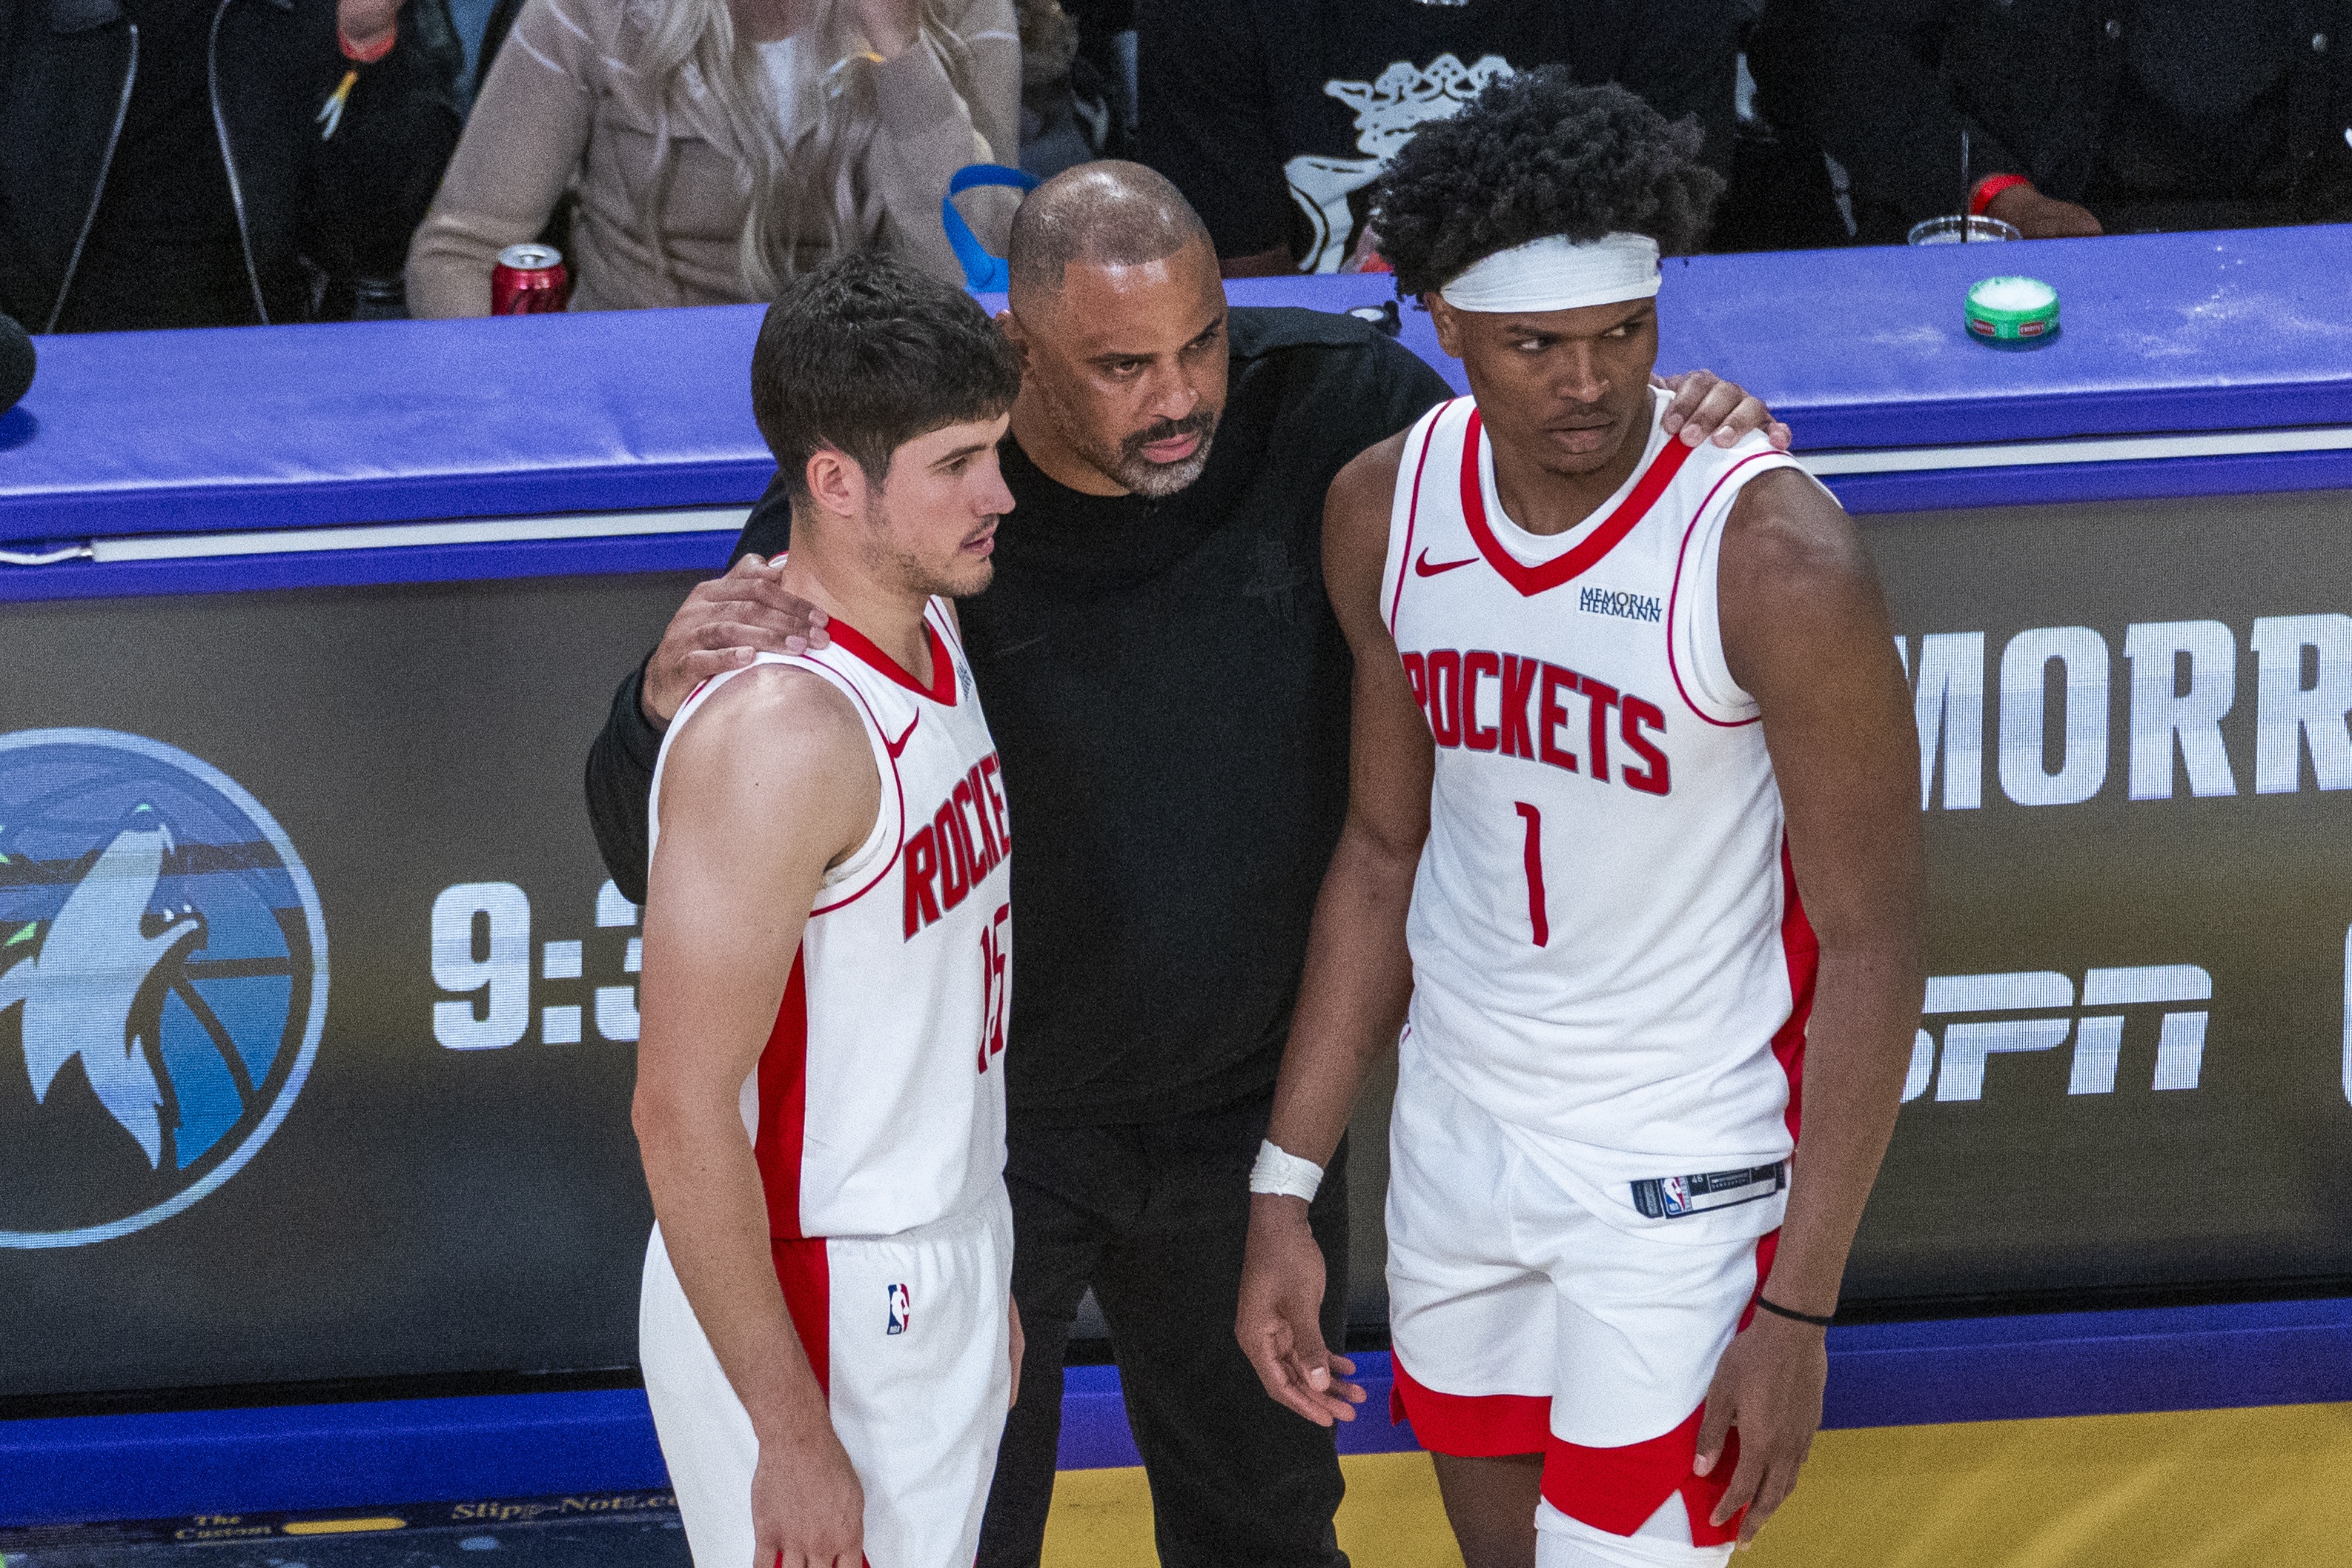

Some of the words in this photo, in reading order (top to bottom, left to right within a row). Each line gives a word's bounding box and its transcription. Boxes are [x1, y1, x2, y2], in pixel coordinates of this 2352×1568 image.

[1580, 596, 1661, 622] HERMANN
[1581, 586, 1662, 611] MEMORIAL
[1514, 800, 1549, 949] 1
[977, 902, 1010, 1075] 15
